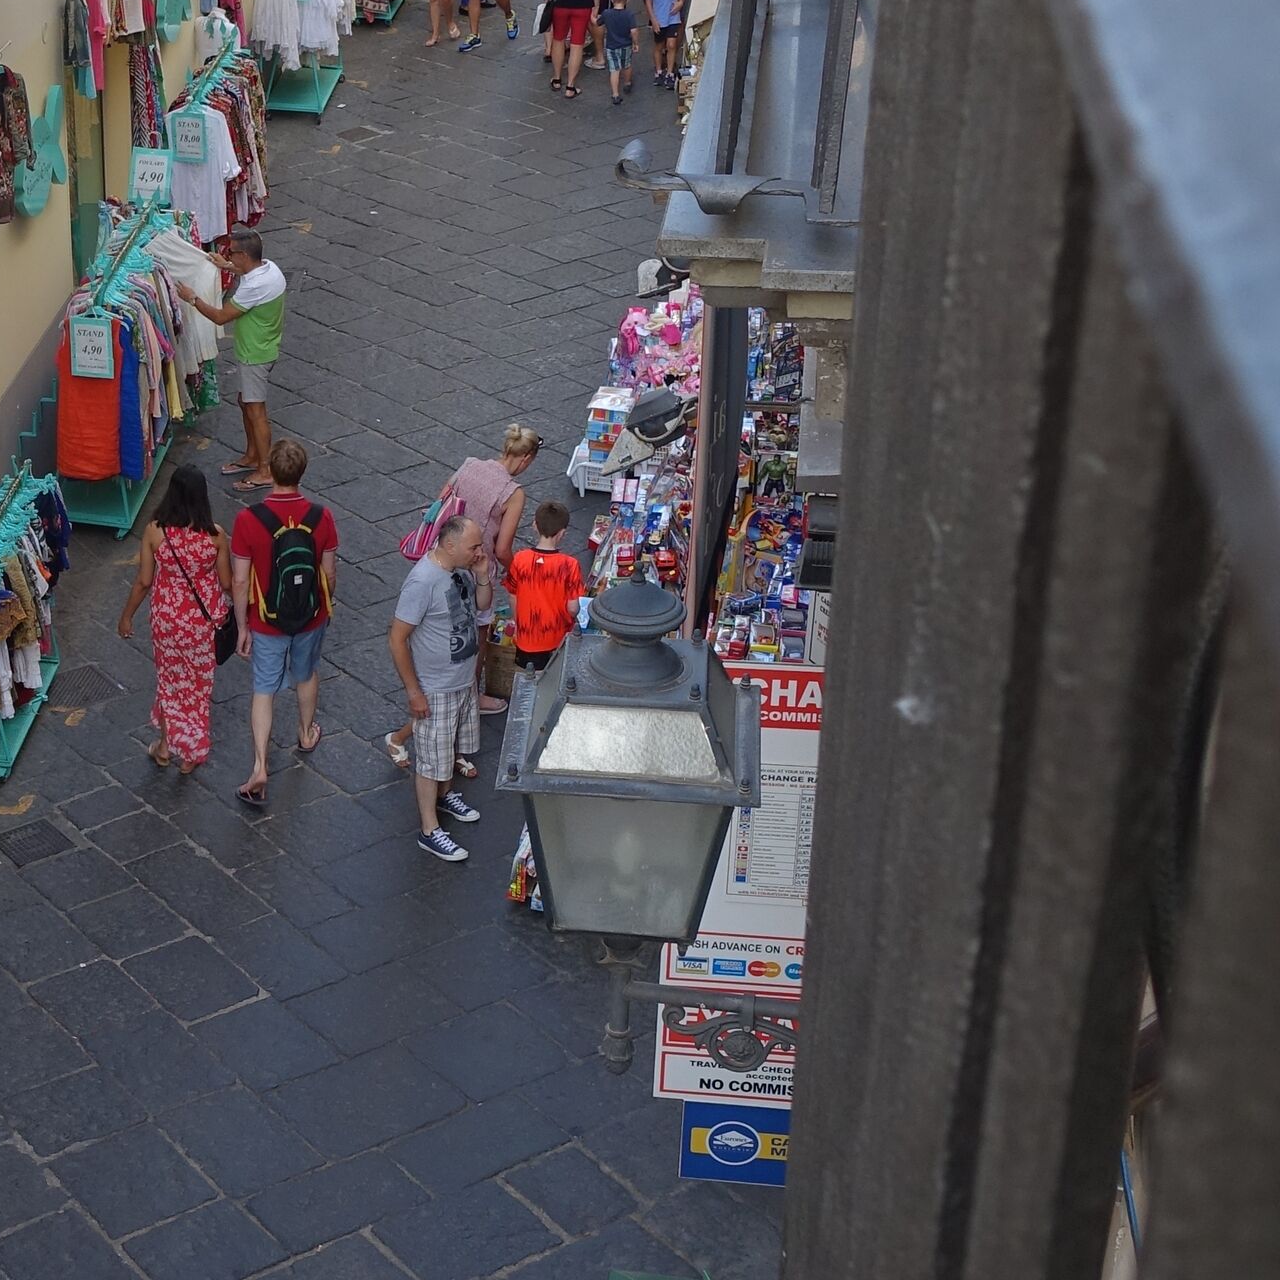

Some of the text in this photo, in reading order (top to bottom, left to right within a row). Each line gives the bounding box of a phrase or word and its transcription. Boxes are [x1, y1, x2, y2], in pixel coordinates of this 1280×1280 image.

[177, 121, 200, 129] STAND
[180, 133, 200, 143] 18,00
[138, 170, 164, 183] 4,90
[76, 328, 104, 338] STAND
[81, 345, 103, 355] 4,90
[711, 941, 762, 953] ADVANCE
[765, 945, 781, 954] ON
[786, 946, 806, 956] CR
[682, 961, 702, 969] VISA
[761, 1065, 795, 1074] CHEQ
[745, 1073, 793, 1082] accepted
[699, 1078, 724, 1090] NO
